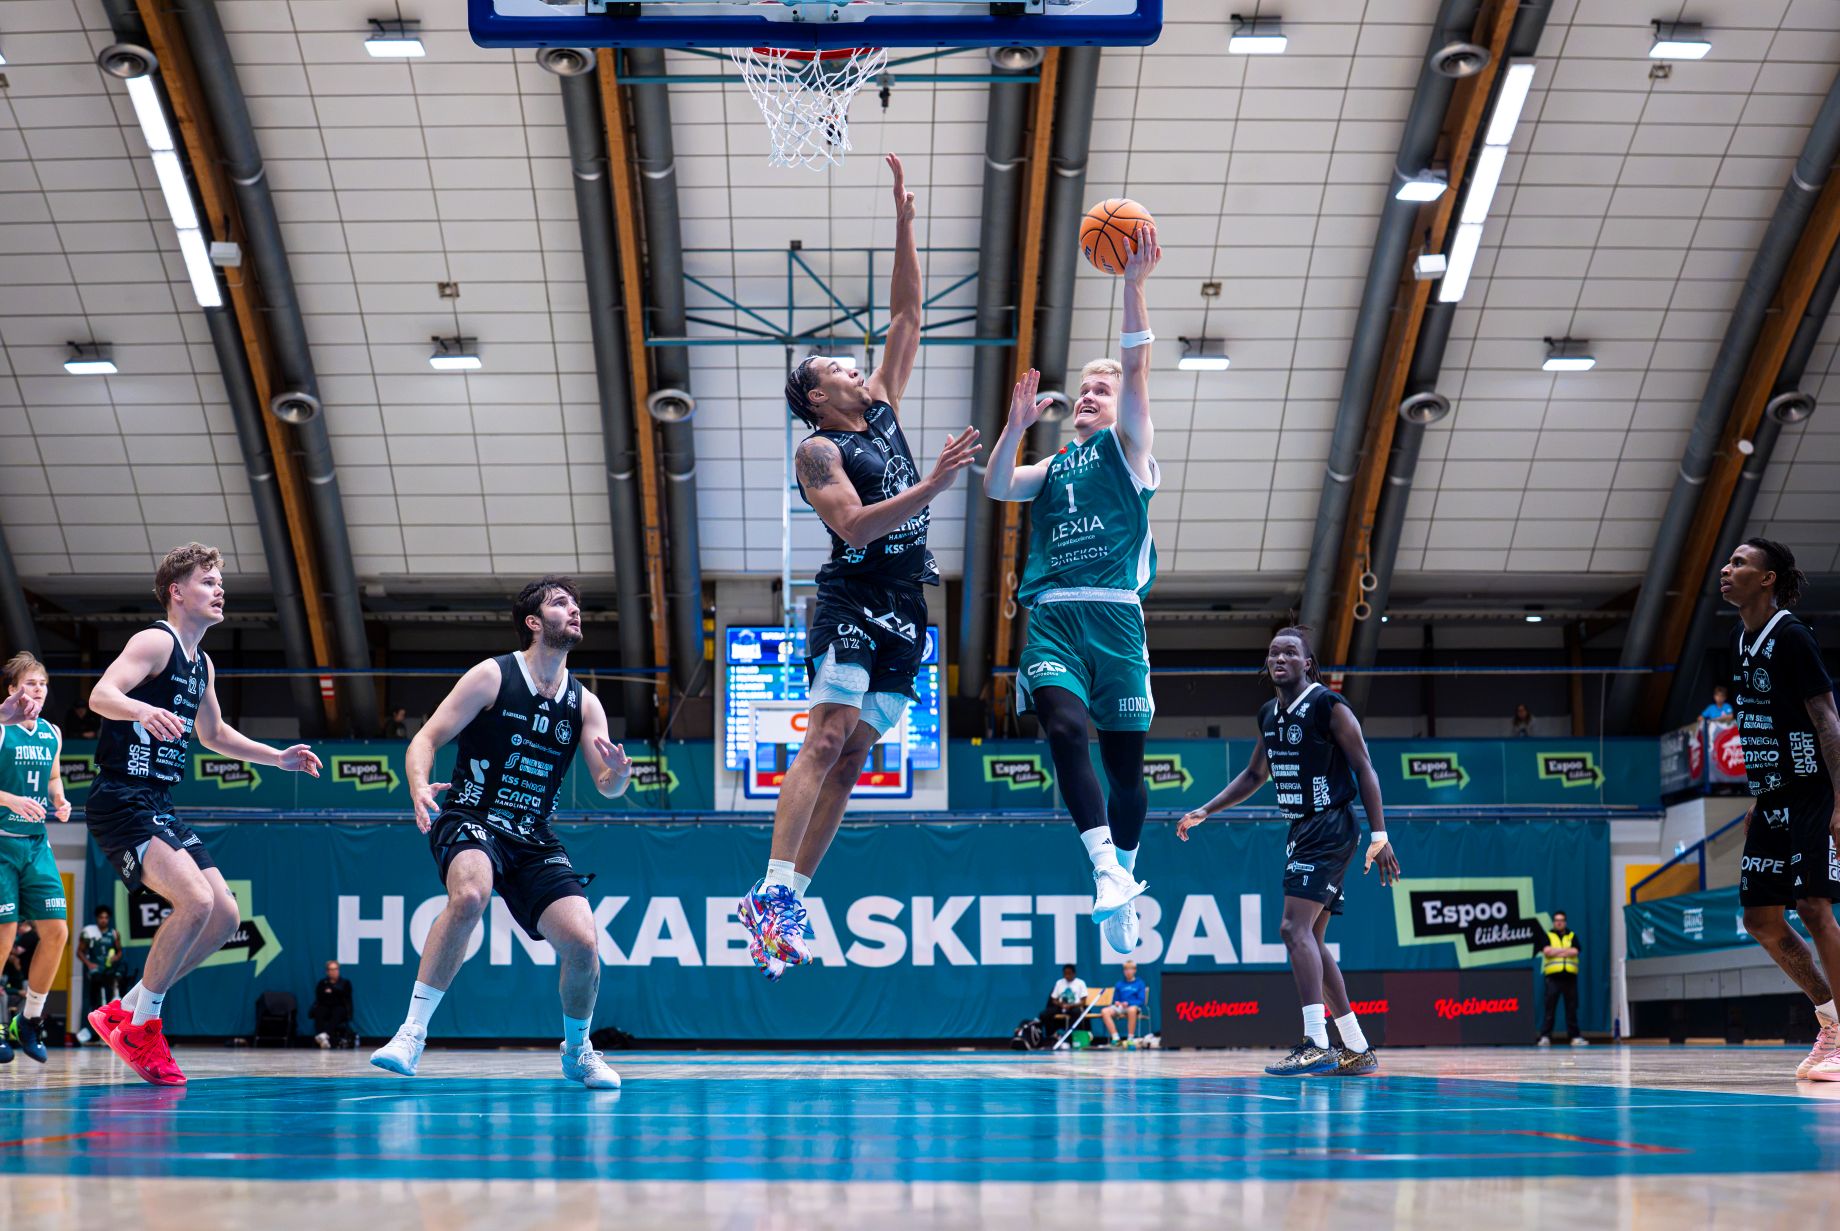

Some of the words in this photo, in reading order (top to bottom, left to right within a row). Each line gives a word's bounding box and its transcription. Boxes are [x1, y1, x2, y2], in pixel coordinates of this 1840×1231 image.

[1065, 483, 1078, 514] 1
[1052, 515, 1105, 542] LEXIA
[885, 544, 904, 555] KSS
[1050, 545, 1109, 568] DAREKON
[841, 637, 860, 650] 12
[532, 713, 550, 734] 10
[1278, 726, 1285, 742] 1
[15, 745, 53, 761] HONKA
[1789, 731, 1806, 774] INTER
[1800, 731, 1818, 774] SPORT
[205, 762, 240, 774] Espoo
[342, 762, 378, 776] Espoo
[994, 762, 1032, 774] Espoo
[1412, 761, 1448, 773] Espoo
[1548, 760, 1584, 772] Espoo
[27, 770, 40, 792] 4
[501, 773, 520, 787] KSS
[1279, 782, 1302, 791] ENERGIA
[1312, 776, 1323, 807] INTER
[494, 798, 528, 811] HANDLING
[1741, 855, 1785, 874] ORPE
[1422, 900, 1508, 928] Espoo
[1474, 923, 1534, 945] liikkuu
[1176, 1000, 1259, 1022] Kotivara
[1434, 997, 1520, 1020] Kotivara
